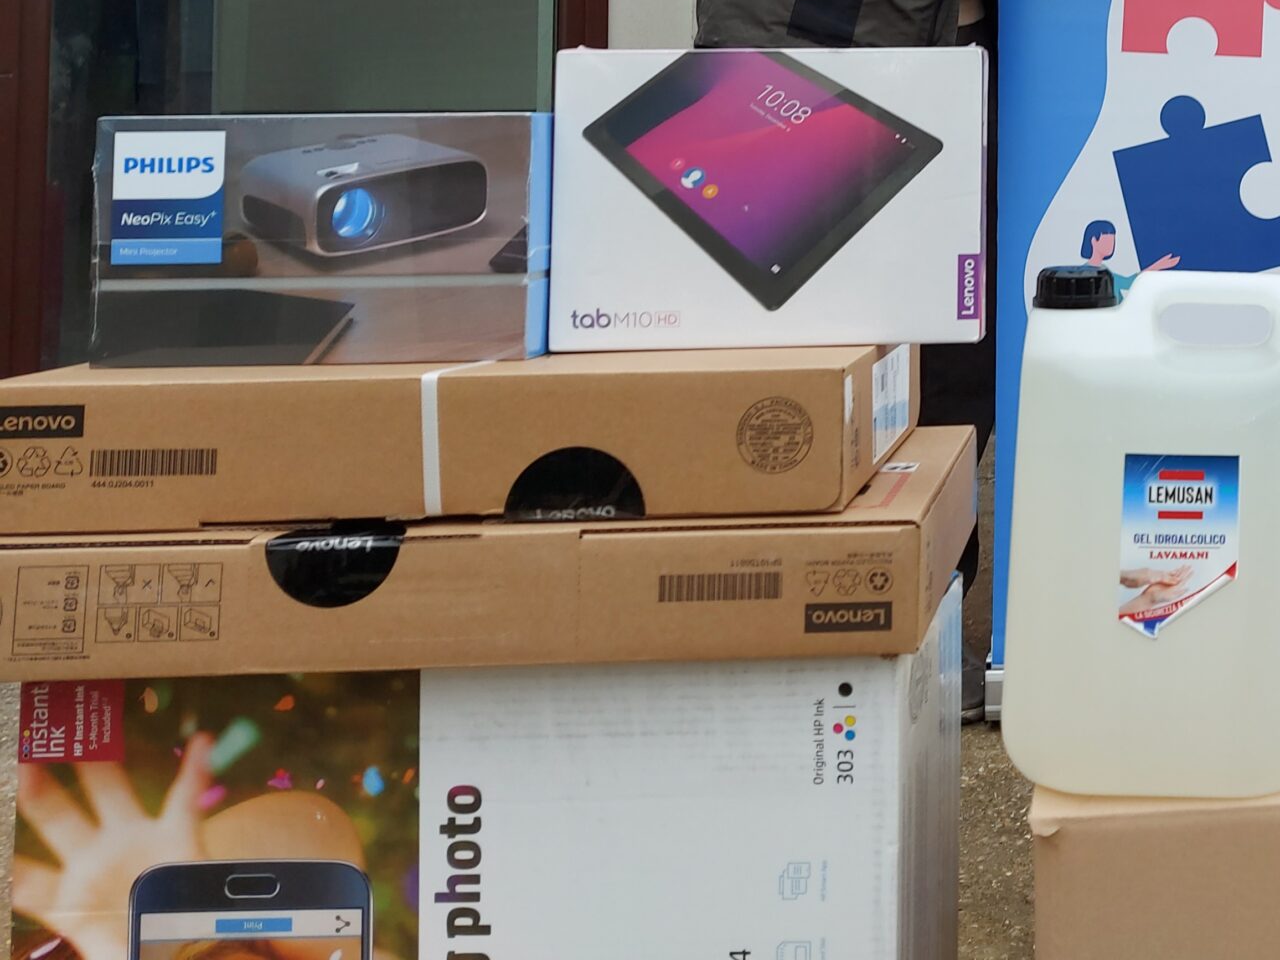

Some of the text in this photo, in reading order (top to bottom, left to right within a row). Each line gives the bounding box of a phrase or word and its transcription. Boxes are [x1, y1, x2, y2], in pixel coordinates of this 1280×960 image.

[755, 82, 812, 127] 10:08
[123, 156, 216, 175] PHILIPS
[120, 212, 172, 227] NeoPix
[961, 258, 976, 317] Lenovo
[0, 414, 76, 431] enovo
[1148, 485, 1214, 505] LEMUSAN
[1133, 532, 1226, 546] GEL IDROALCOLICO
[1149, 550, 1209, 560] LAVAMANI
[812, 607, 885, 626] Lenovo
[74, 685, 85, 757] HP Instant Ink
[812, 698, 826, 786] Original HP Ink
[836, 749, 854, 785] 303
[434, 784, 492, 939] photo
